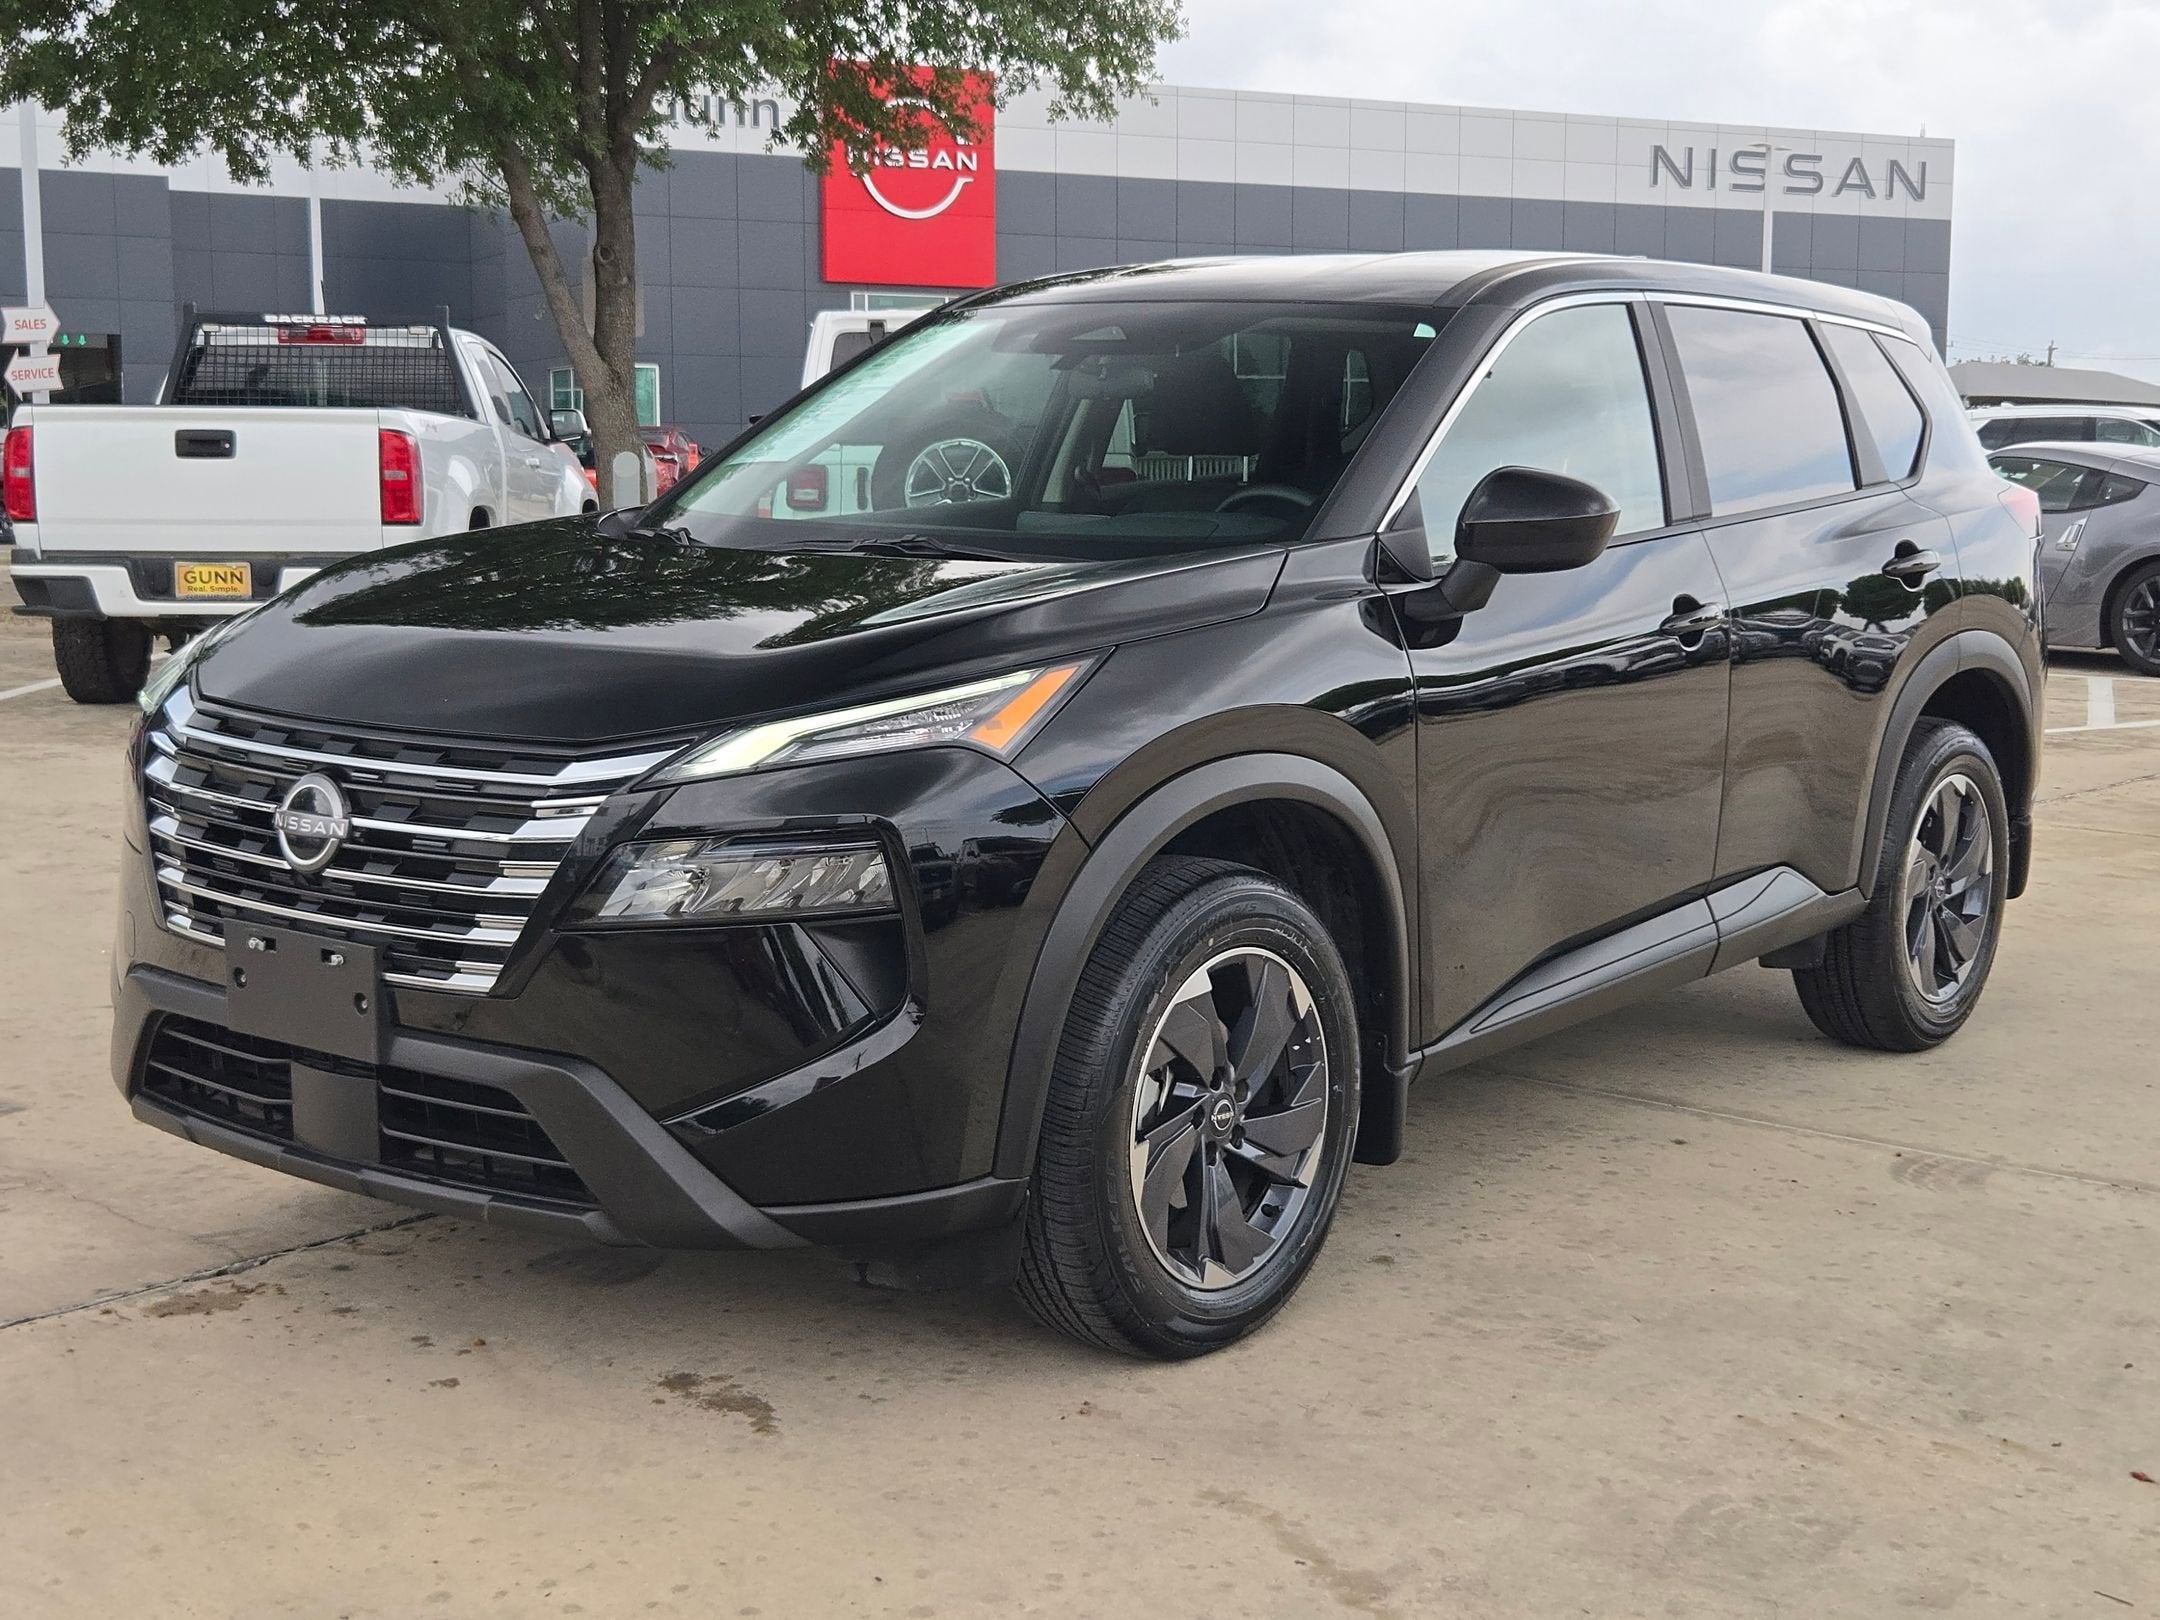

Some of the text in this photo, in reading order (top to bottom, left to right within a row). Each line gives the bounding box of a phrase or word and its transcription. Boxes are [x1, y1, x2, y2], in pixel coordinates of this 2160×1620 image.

[1650, 144, 1927, 202] NISSAN
[14, 319, 47, 330] SALES
[11, 367, 55, 381] SERVICE
[183, 570, 244, 584] GUNN
[187, 585, 240, 593] Real. Simple.
[275, 812, 345, 836] NISSAN
